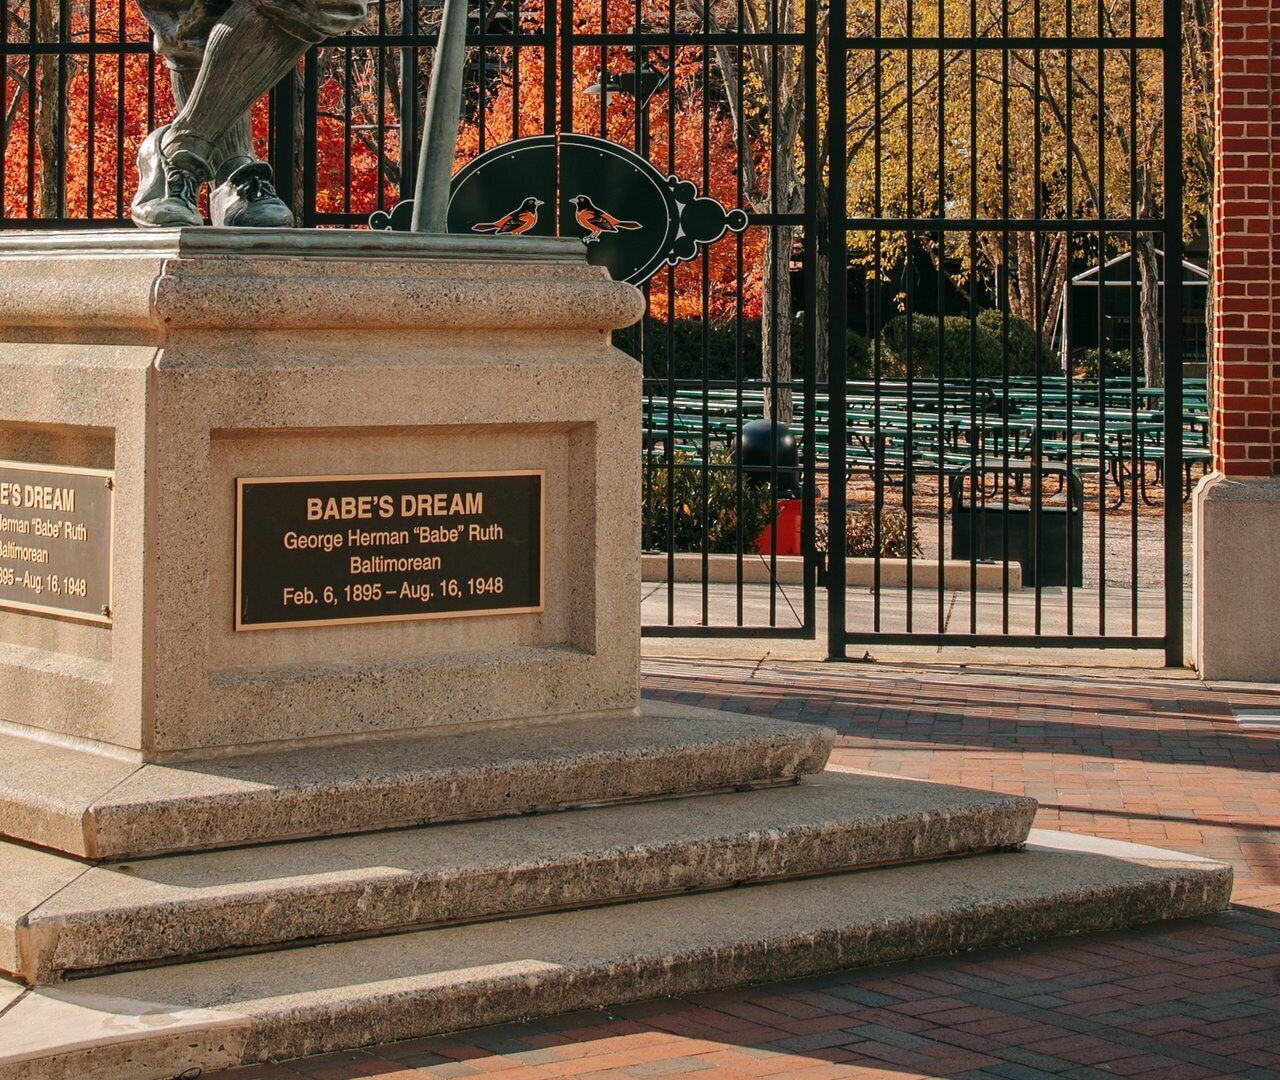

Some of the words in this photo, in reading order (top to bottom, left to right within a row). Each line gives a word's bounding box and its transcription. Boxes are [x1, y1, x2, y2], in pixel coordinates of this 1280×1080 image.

[24, 485, 76, 512] DREAM
[306, 494, 394, 521] BABE’S
[401, 491, 483, 518] DREAM
[31, 518, 64, 538] “Babe”
[64, 521, 87, 541] Ruth
[283, 530, 343, 553] George
[348, 528, 409, 547] Herman
[413, 524, 464, 544] “Babe”
[468, 523, 503, 542] Ruth
[350, 554, 442, 575] Baltimorean
[23, 570, 44, 594] Aug.
[47, 574, 61, 595] 16,
[63, 577, 87, 597] 1948
[283, 587, 318, 606] Feb.
[323, 585, 338, 606] 6,
[344, 583, 382, 601] 1895
[399, 581, 434, 603] Aug.
[440, 579, 462, 598] 16,
[467, 577, 504, 596] 1948
